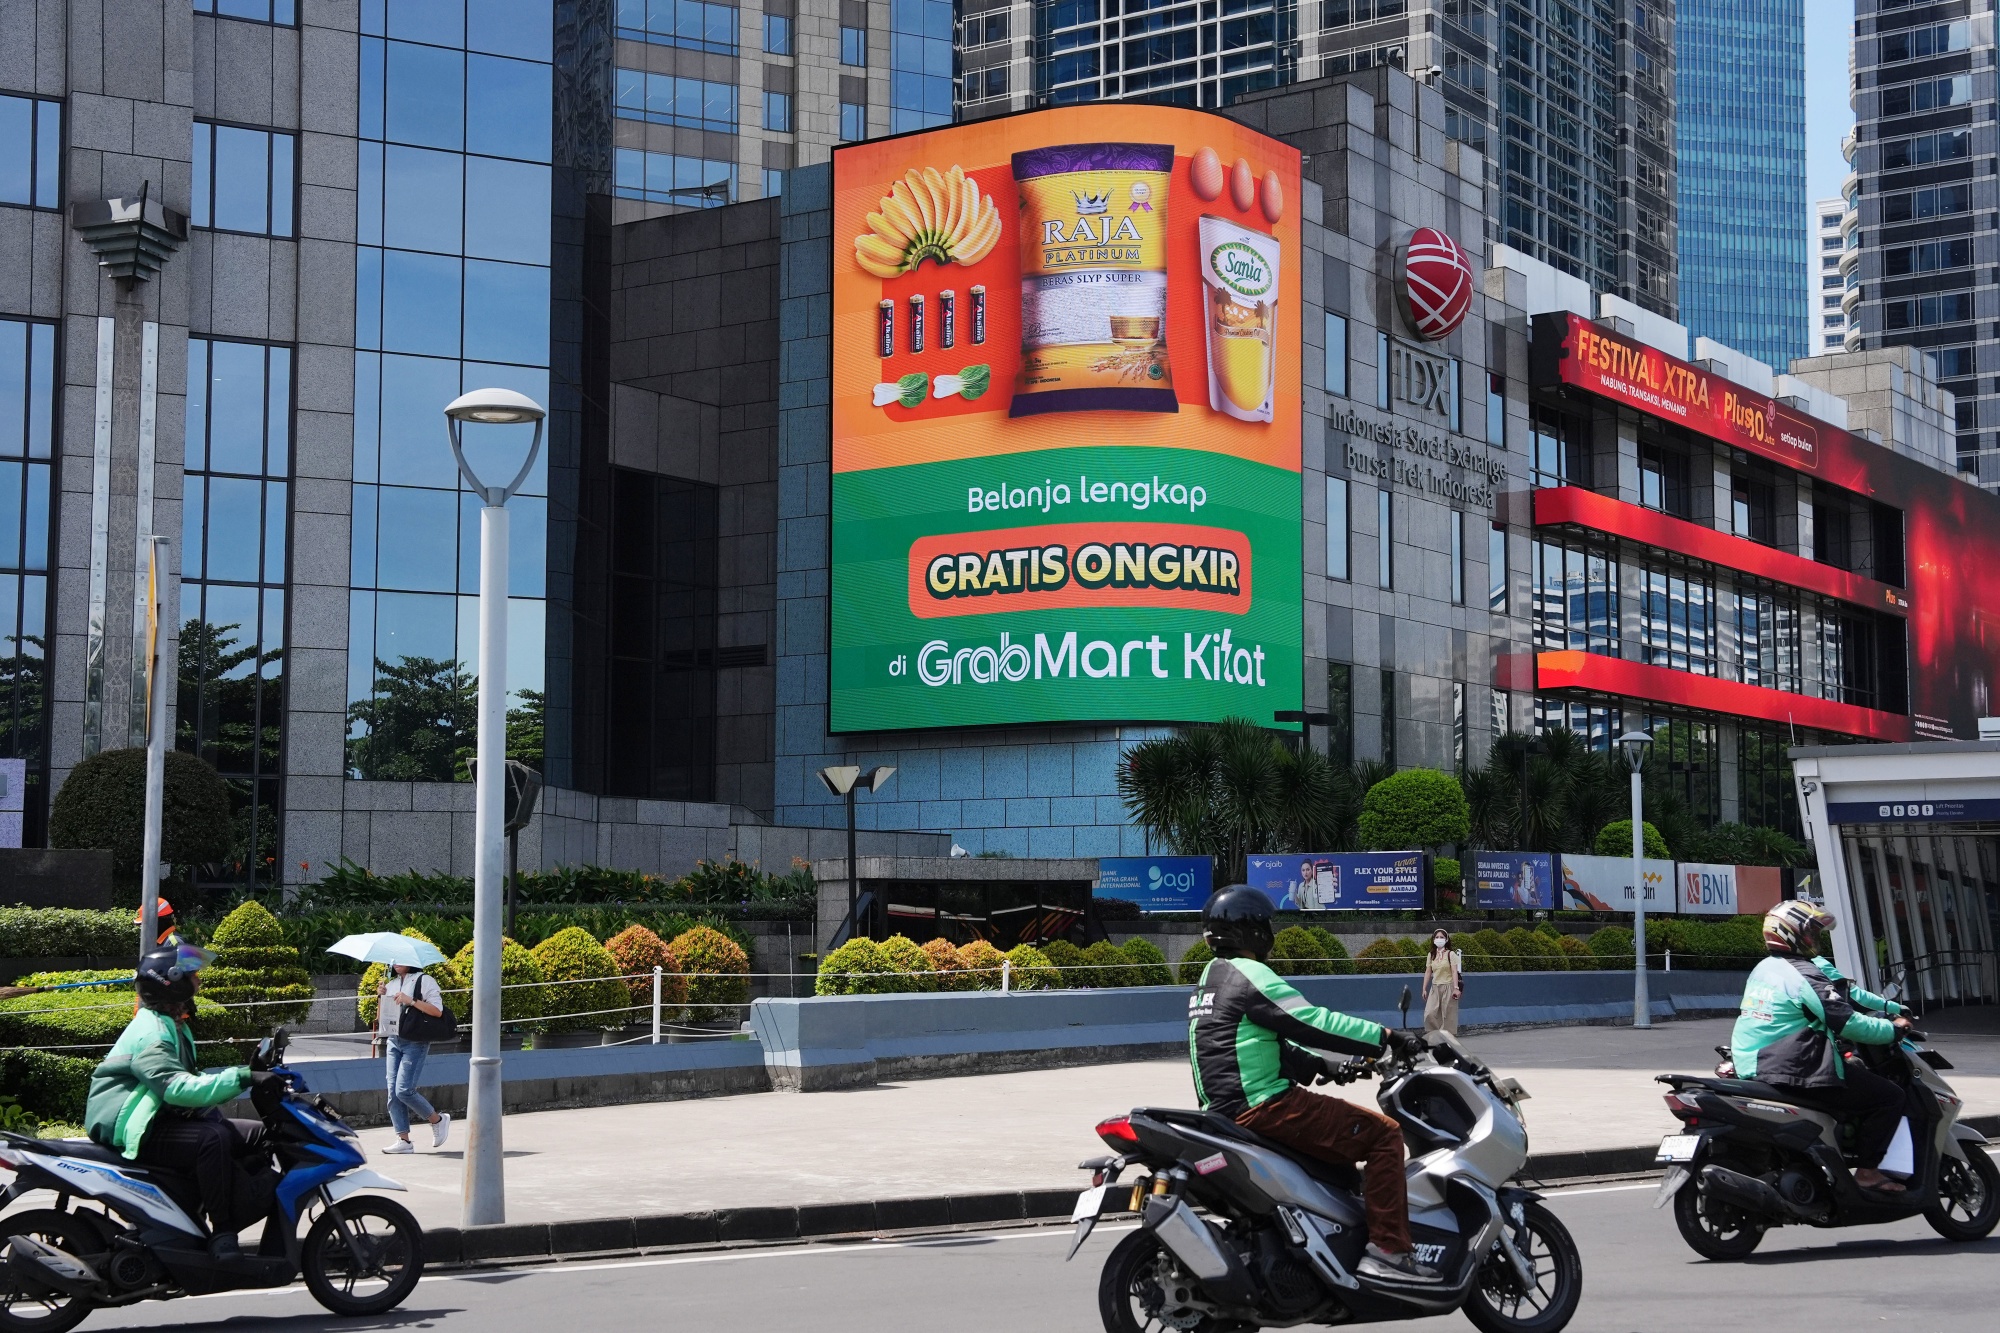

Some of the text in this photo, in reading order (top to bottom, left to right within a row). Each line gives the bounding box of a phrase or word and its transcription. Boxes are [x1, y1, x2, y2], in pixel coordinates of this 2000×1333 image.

[1042, 216, 1143, 247] RAJA
[1046, 249, 1140, 263] PLATINUM
[1225, 251, 1262, 282] Sania
[1042, 274, 1142, 287] BERAS SLYP SUPER
[1399, 350, 1449, 416] IDX
[1577, 328, 1710, 409] FESTIVAL XTRA
[1600, 374, 1687, 417] NABUNG, TRANSAKSI, MENANG!
[1724, 391, 1752, 429] Plus
[1331, 403, 1507, 485] Indonesia Stock Exchange
[1781, 432, 1813, 453] setiap bulan
[1346, 443, 1494, 509] Bursa Efek Indonesia
[968, 476, 1207, 513] Belanja lengkap
[927, 544, 1239, 597] GRATIS ONGKIR
[888, 628, 1266, 687] di GrabMart Kilat
[1265, 861, 1283, 869] ajaib
[1354, 866, 1417, 875] FLEX YOUR STYLE
[1373, 875, 1417, 883] LEBIH AMAN
[1482, 870, 1492, 878] SATU
[1624, 882, 1655, 900] mdiri
[1701, 873, 1729, 905] BNI
[1746, 1102, 1786, 1113] GEAR
